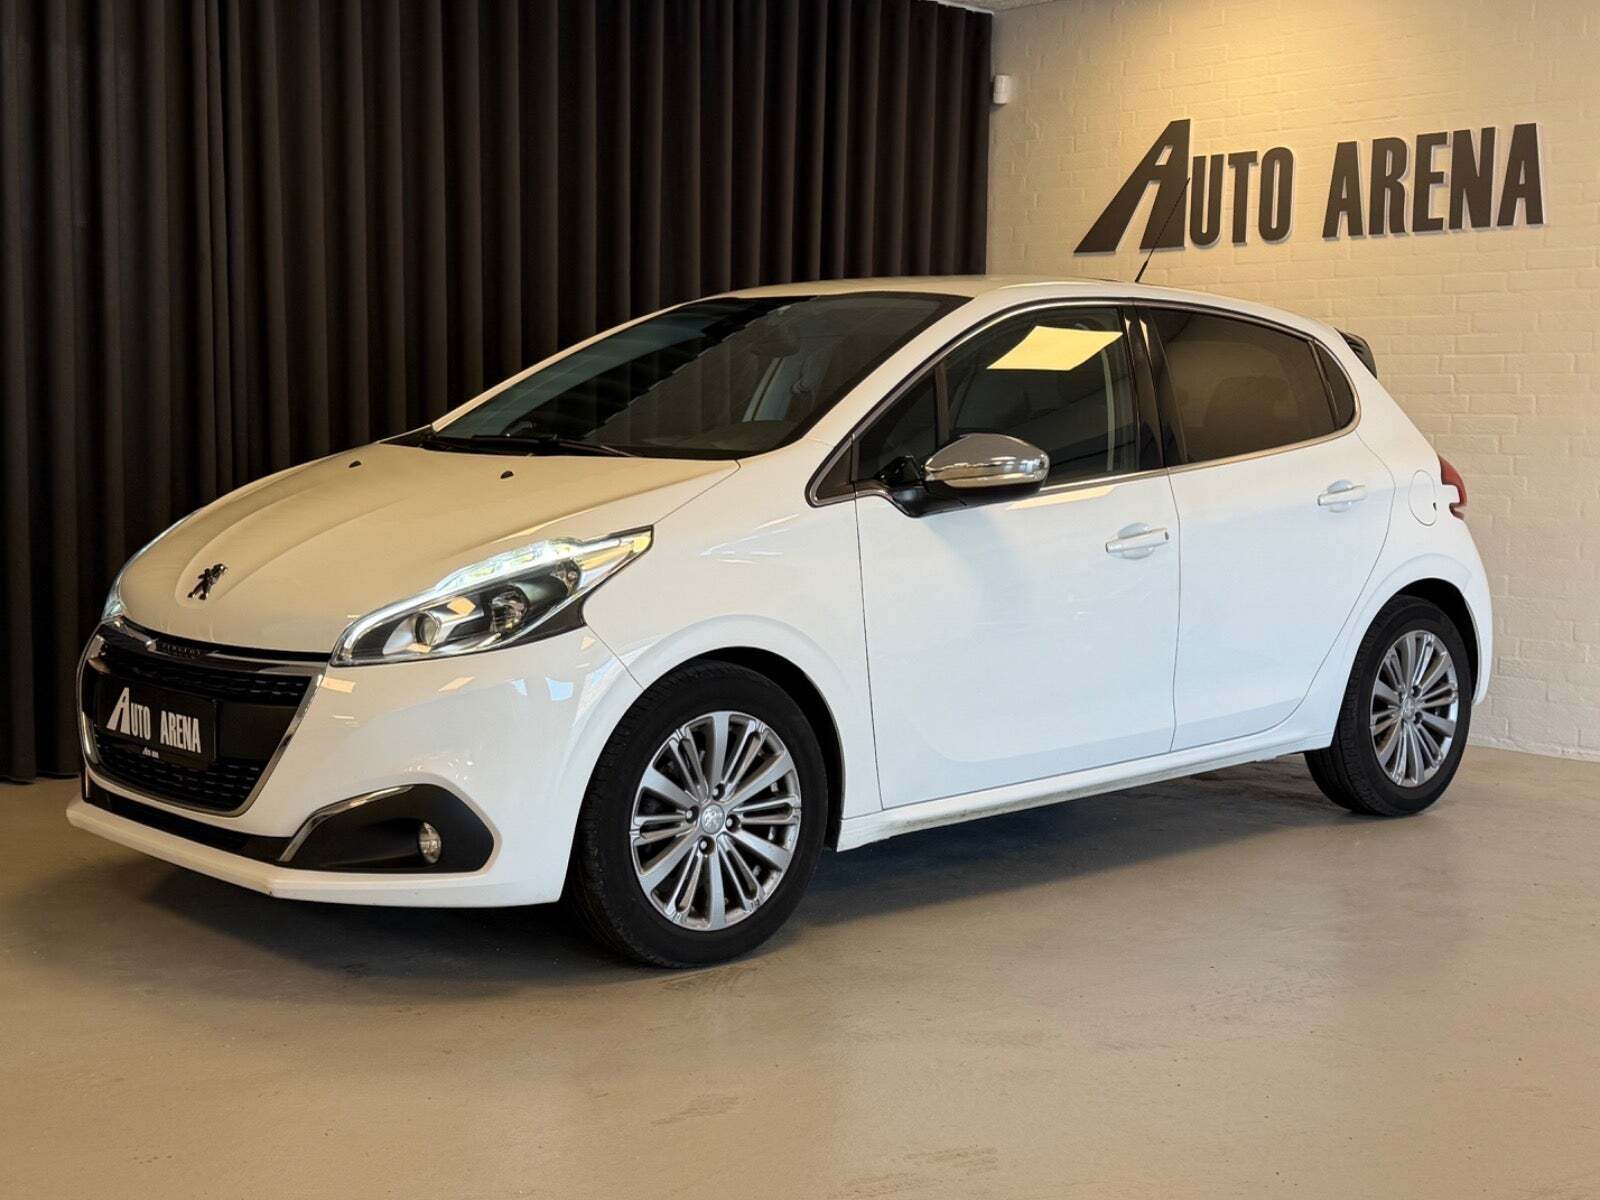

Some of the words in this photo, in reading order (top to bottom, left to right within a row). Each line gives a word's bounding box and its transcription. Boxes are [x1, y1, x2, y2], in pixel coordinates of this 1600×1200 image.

[1073, 118, 1294, 253] AUTO
[1323, 122, 1545, 240] ARENA
[106, 687, 151, 740] AUTO
[160, 710, 201, 753] ARENA
